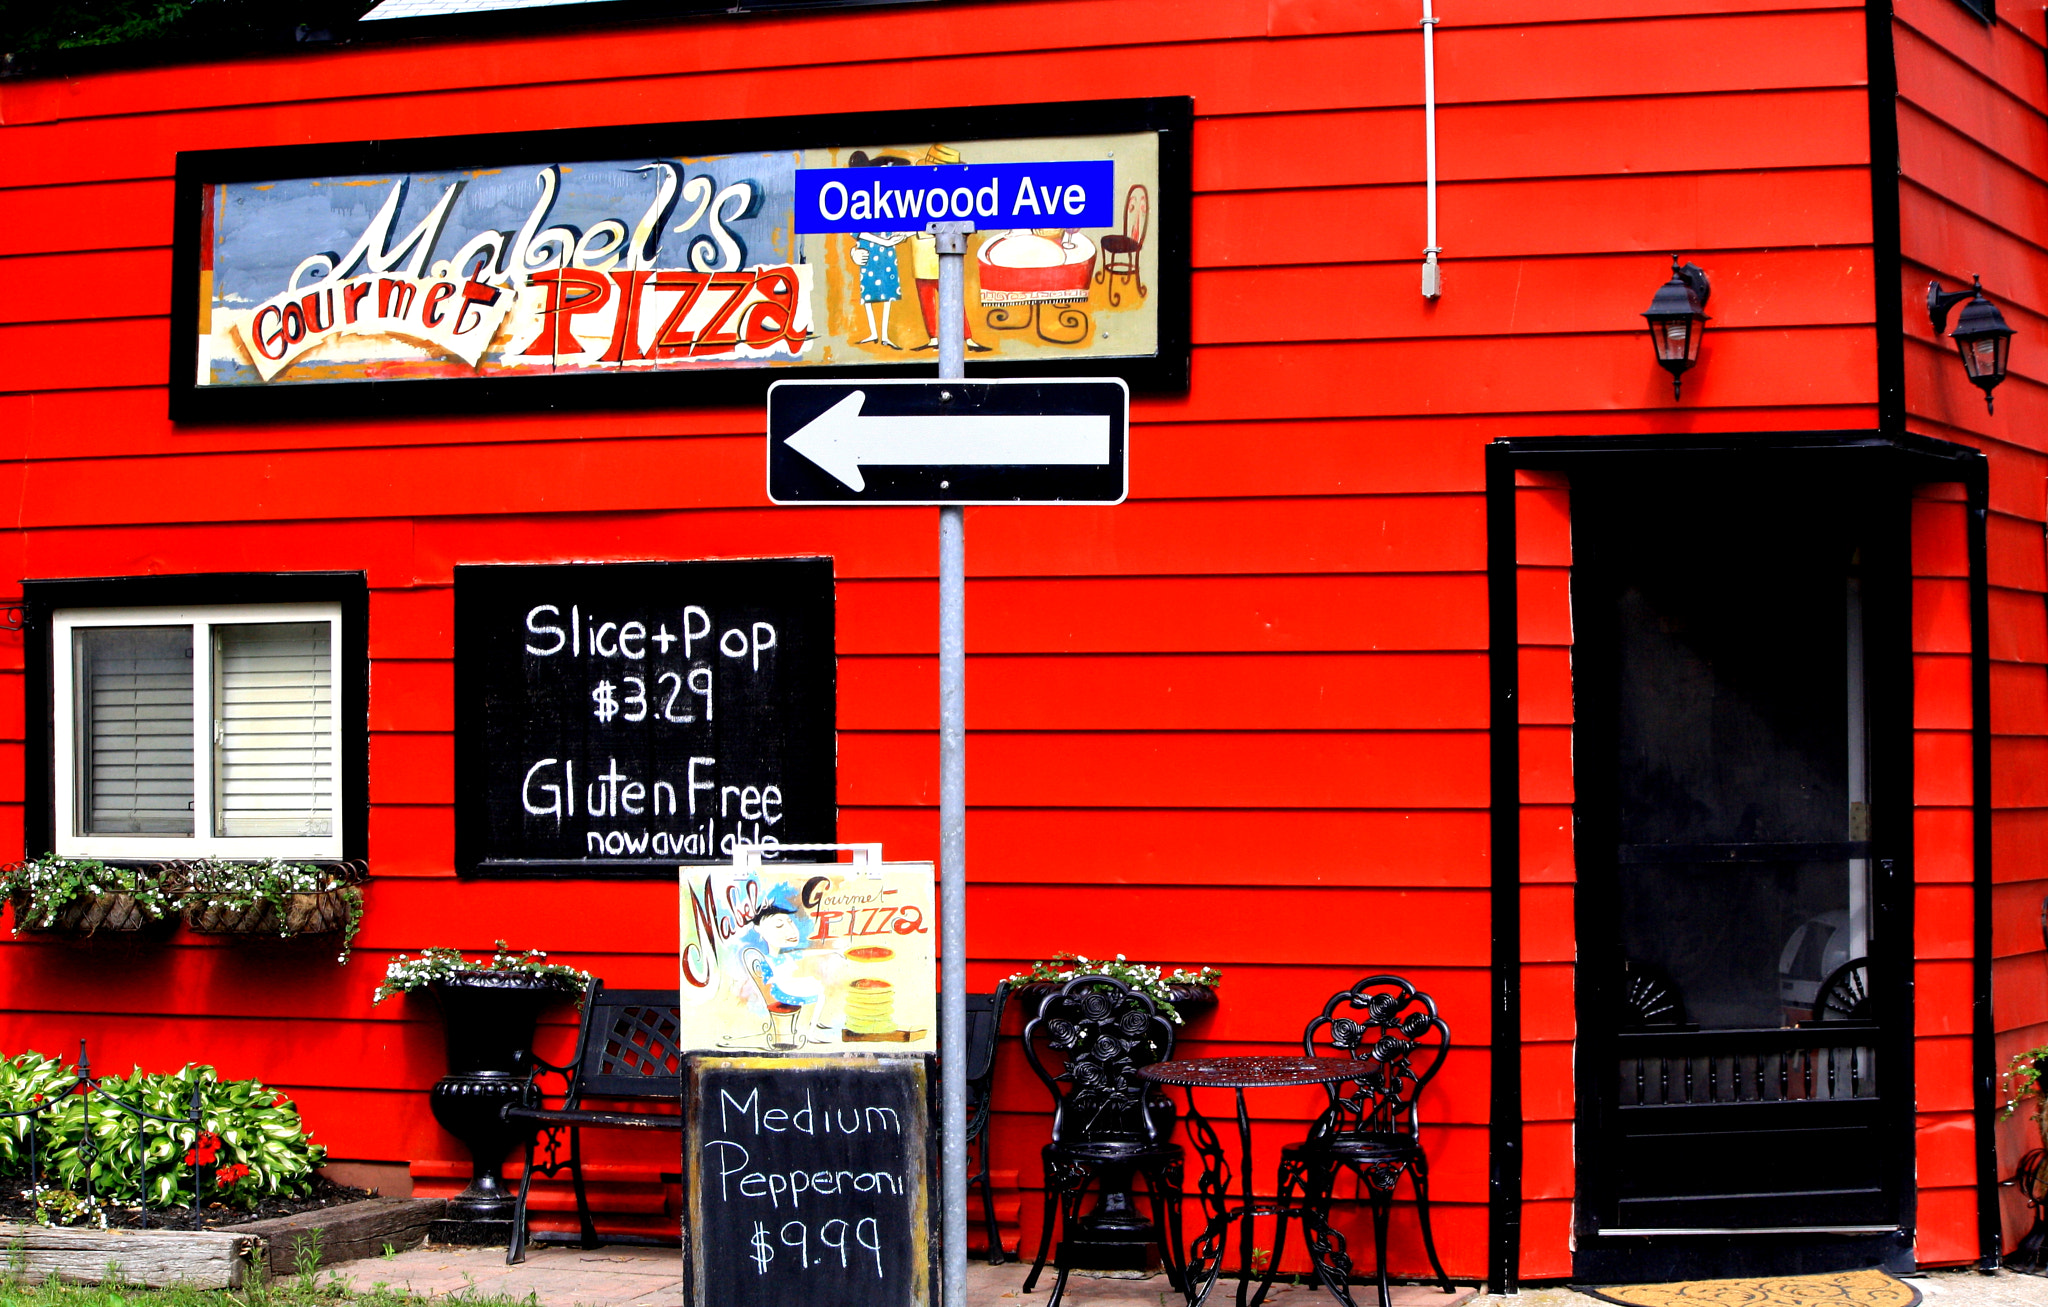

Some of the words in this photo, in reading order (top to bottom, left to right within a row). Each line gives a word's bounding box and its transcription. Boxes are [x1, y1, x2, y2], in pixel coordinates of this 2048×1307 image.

[288, 161, 762, 292] Mabel's
[818, 177, 999, 221] Oakwood
[1011, 176, 1087, 216] Ave
[252, 260, 503, 360] Gourmet
[592, 667, 713, 723] $3.29
[522, 758, 676, 819] Gluten
[687, 757, 782, 824] Free
[587, 830, 649, 855] now
[802, 876, 898, 920] Gourmet
[720, 1087, 901, 1136] Medium
[704, 1140, 904, 1209] Pepperoni
[749, 1217, 883, 1279] $9.99
